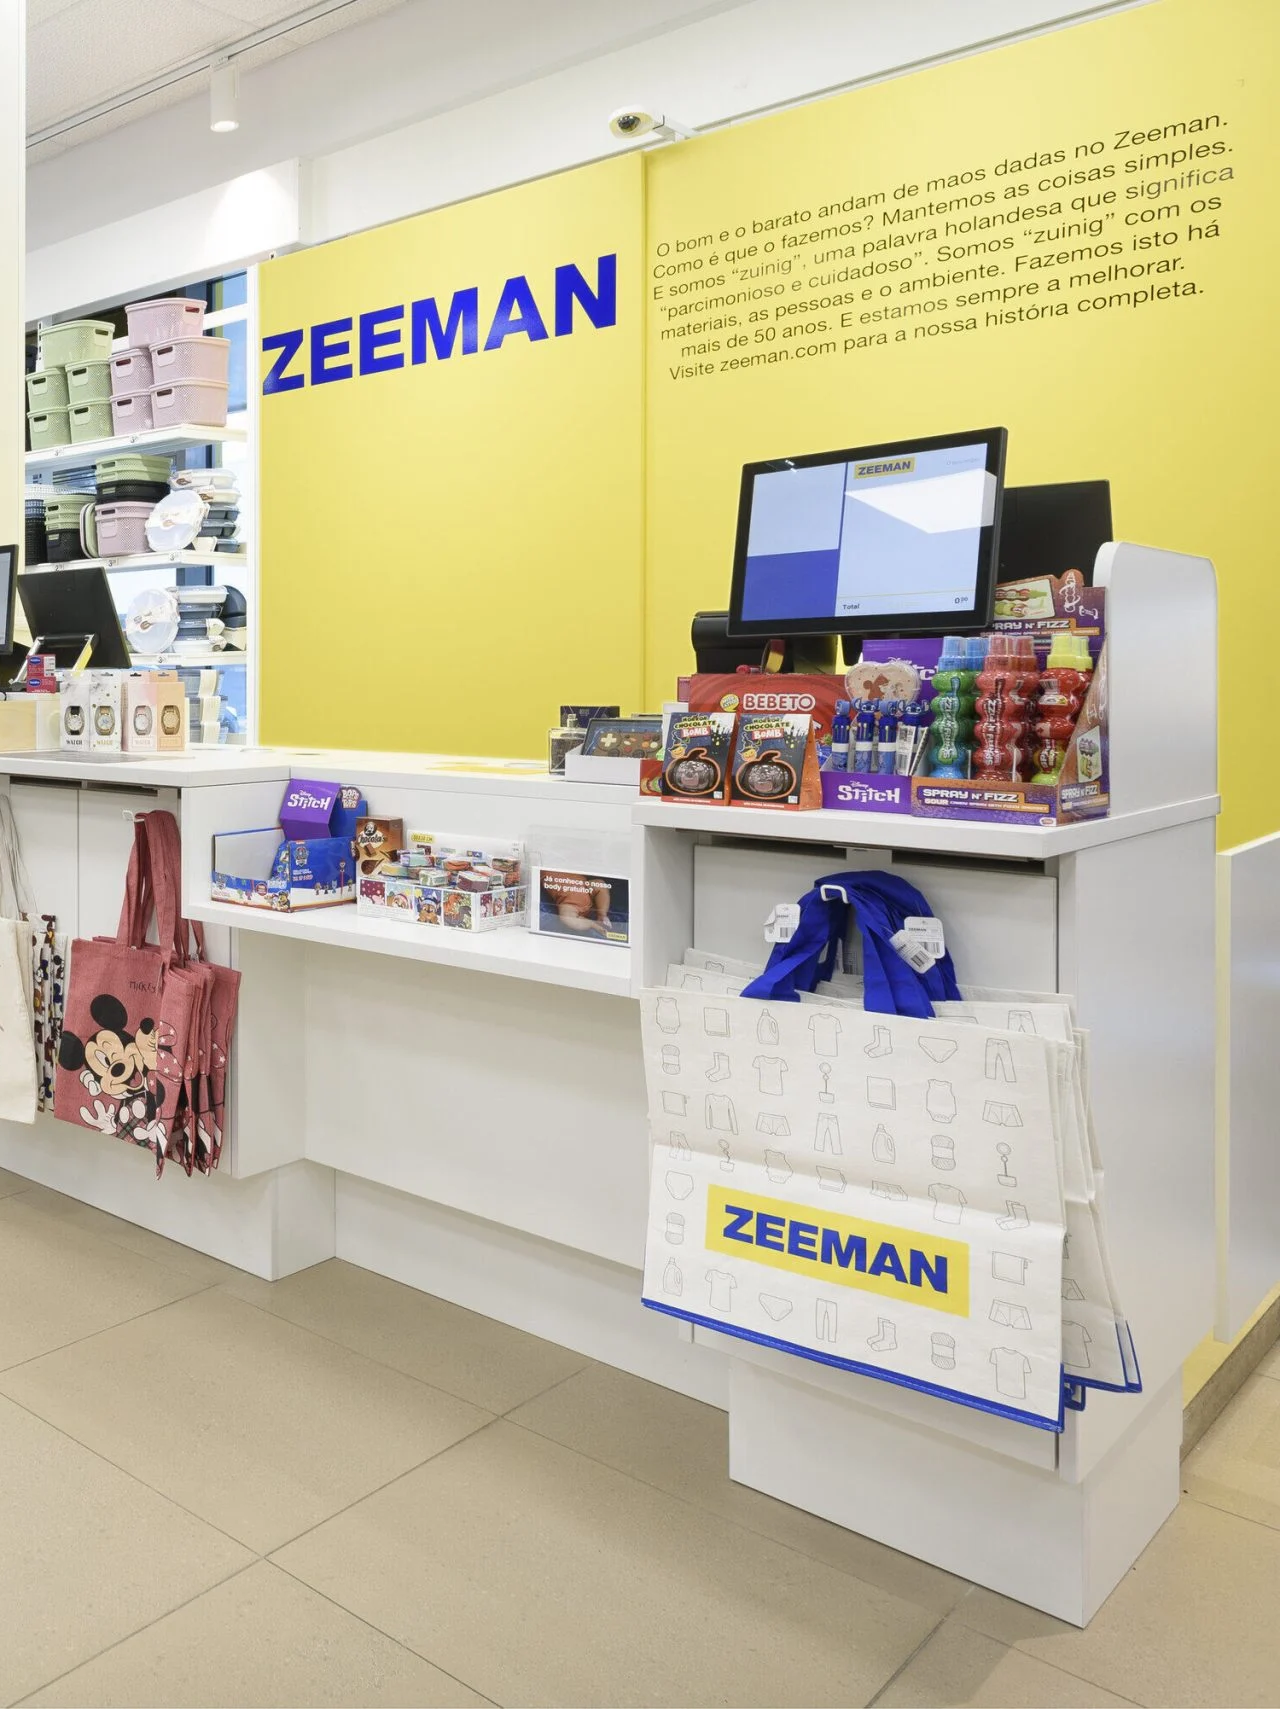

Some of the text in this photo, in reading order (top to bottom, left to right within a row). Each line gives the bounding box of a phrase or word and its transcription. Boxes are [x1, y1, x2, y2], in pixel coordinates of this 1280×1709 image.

[653, 141, 1232, 279] Como é que o fazemos? Mantemos as coisas simples.
[656, 115, 1228, 257] O bom e o barato andam de maos dadas no Zeeman.
[654, 285, 664, 300] E
[670, 274, 725, 296] somos
[814, 246, 856, 264] uma
[863, 228, 938, 258] palavra
[946, 202, 1062, 237] holandesa
[1071, 191, 1116, 213] que
[1125, 167, 1234, 200] significa
[792, 280, 802, 292] e
[937, 237, 1014, 262] Somos
[1124, 204, 1180, 226] com
[1190, 196, 1222, 214] os
[262, 253, 617, 396] ZEEMAN
[661, 219, 1220, 340] materiais, as pessoas e o ambiente. Fazemos isto há
[681, 256, 1184, 358] mais de 50 anos. E estamos sempre a melhorar.
[669, 362, 714, 380] Visite
[720, 342, 836, 372] zeeman.com
[844, 333, 888, 354] para
[895, 330, 906, 342] a
[914, 318, 978, 339] nossa
[1078, 280, 1204, 312] completa.
[858, 461, 911, 476] ZEEMAN
[1037, 620, 1070, 629] FIZZ
[674, 720, 716, 729] CHOCOLATE
[743, 694, 815, 711] BEBETO
[745, 722, 790, 731] CHOCOLATE
[923, 788, 969, 799] SPRAY
[984, 792, 1019, 802] FIZZ
[544, 883, 593, 894] body gratuito?
[554, 877, 583, 886] conhece
[591, 881, 612, 889] nosso
[723, 1204, 948, 1294] ZEEMAN
